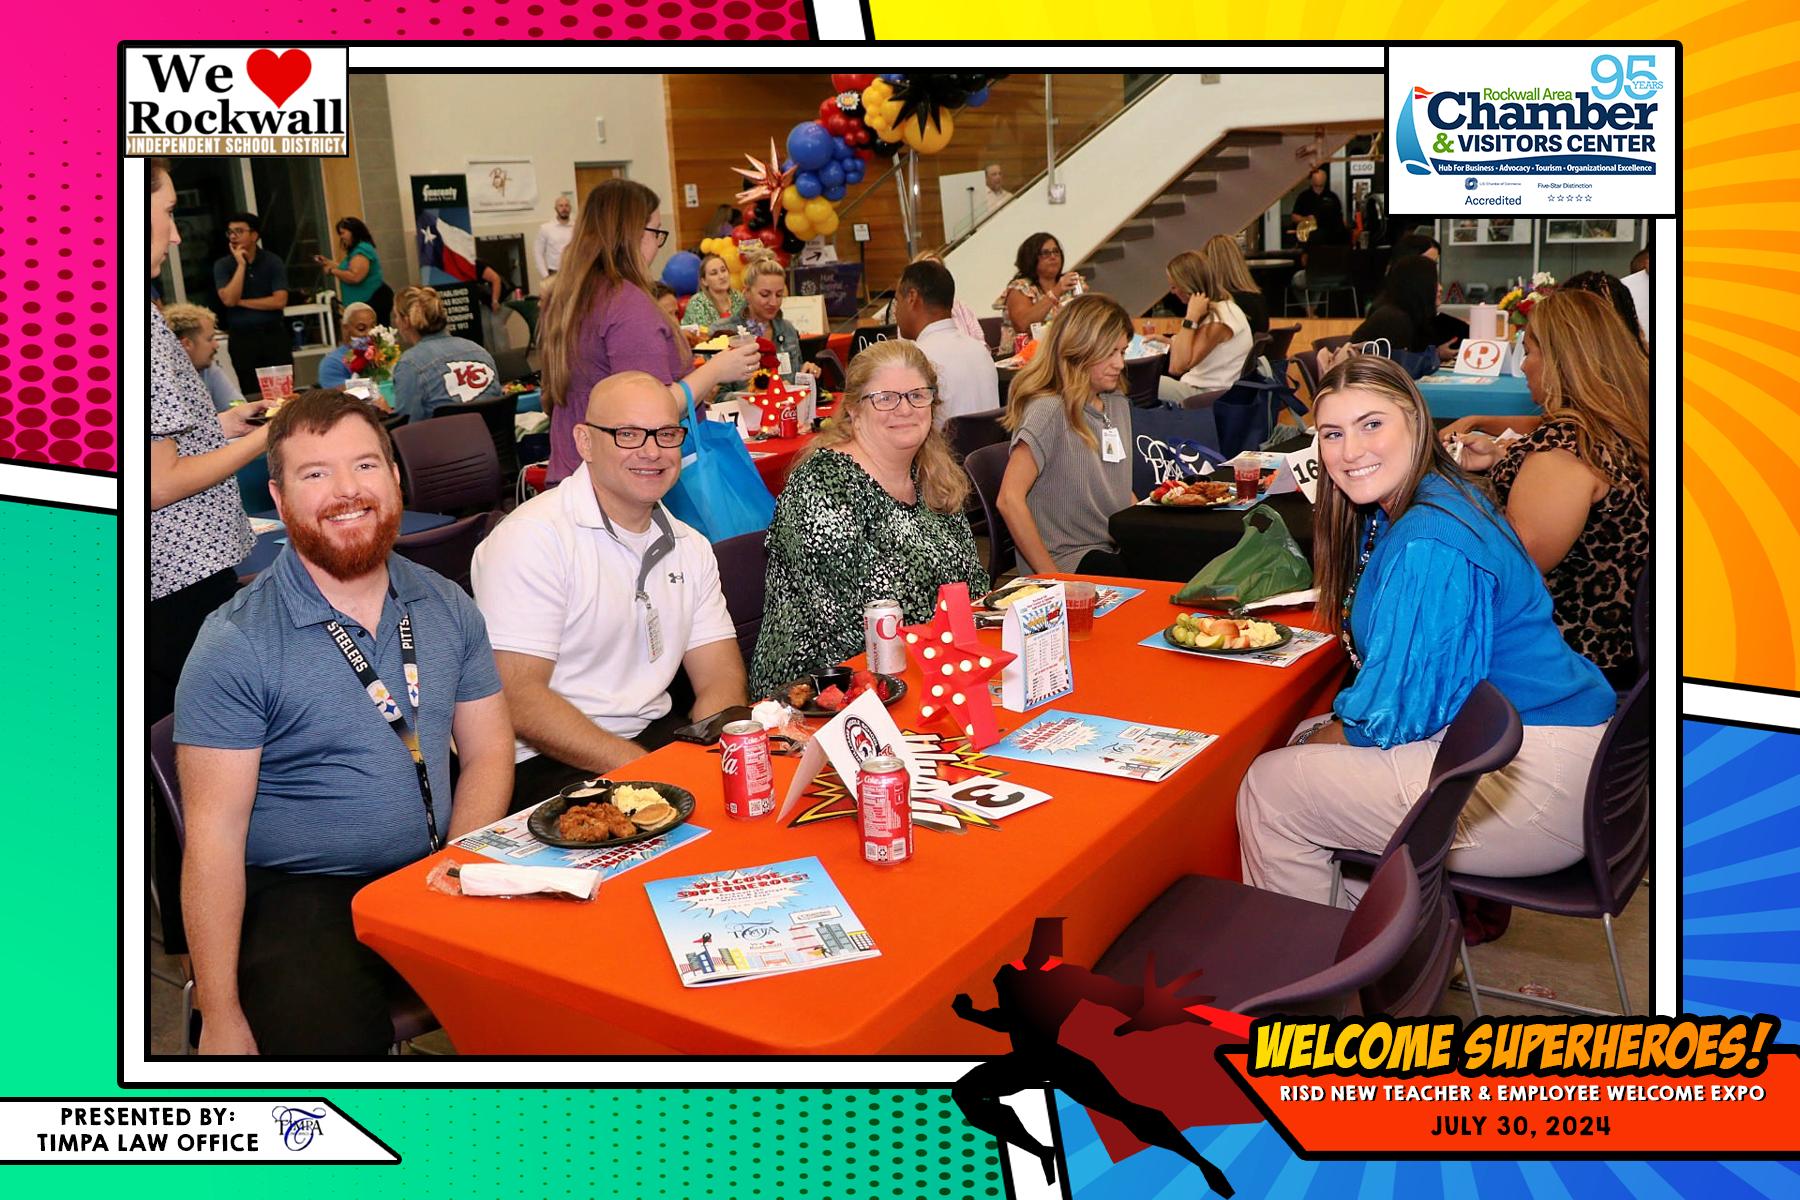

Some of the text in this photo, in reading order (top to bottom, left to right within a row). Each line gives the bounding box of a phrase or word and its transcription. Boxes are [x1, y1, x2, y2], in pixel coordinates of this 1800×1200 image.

[453, 364, 488, 389] KC
[399, 615, 414, 650] PITTS
[327, 621, 368, 673] STEELERS
[951, 784, 1025, 808] 3
[692, 872, 781, 890] WELCOME
